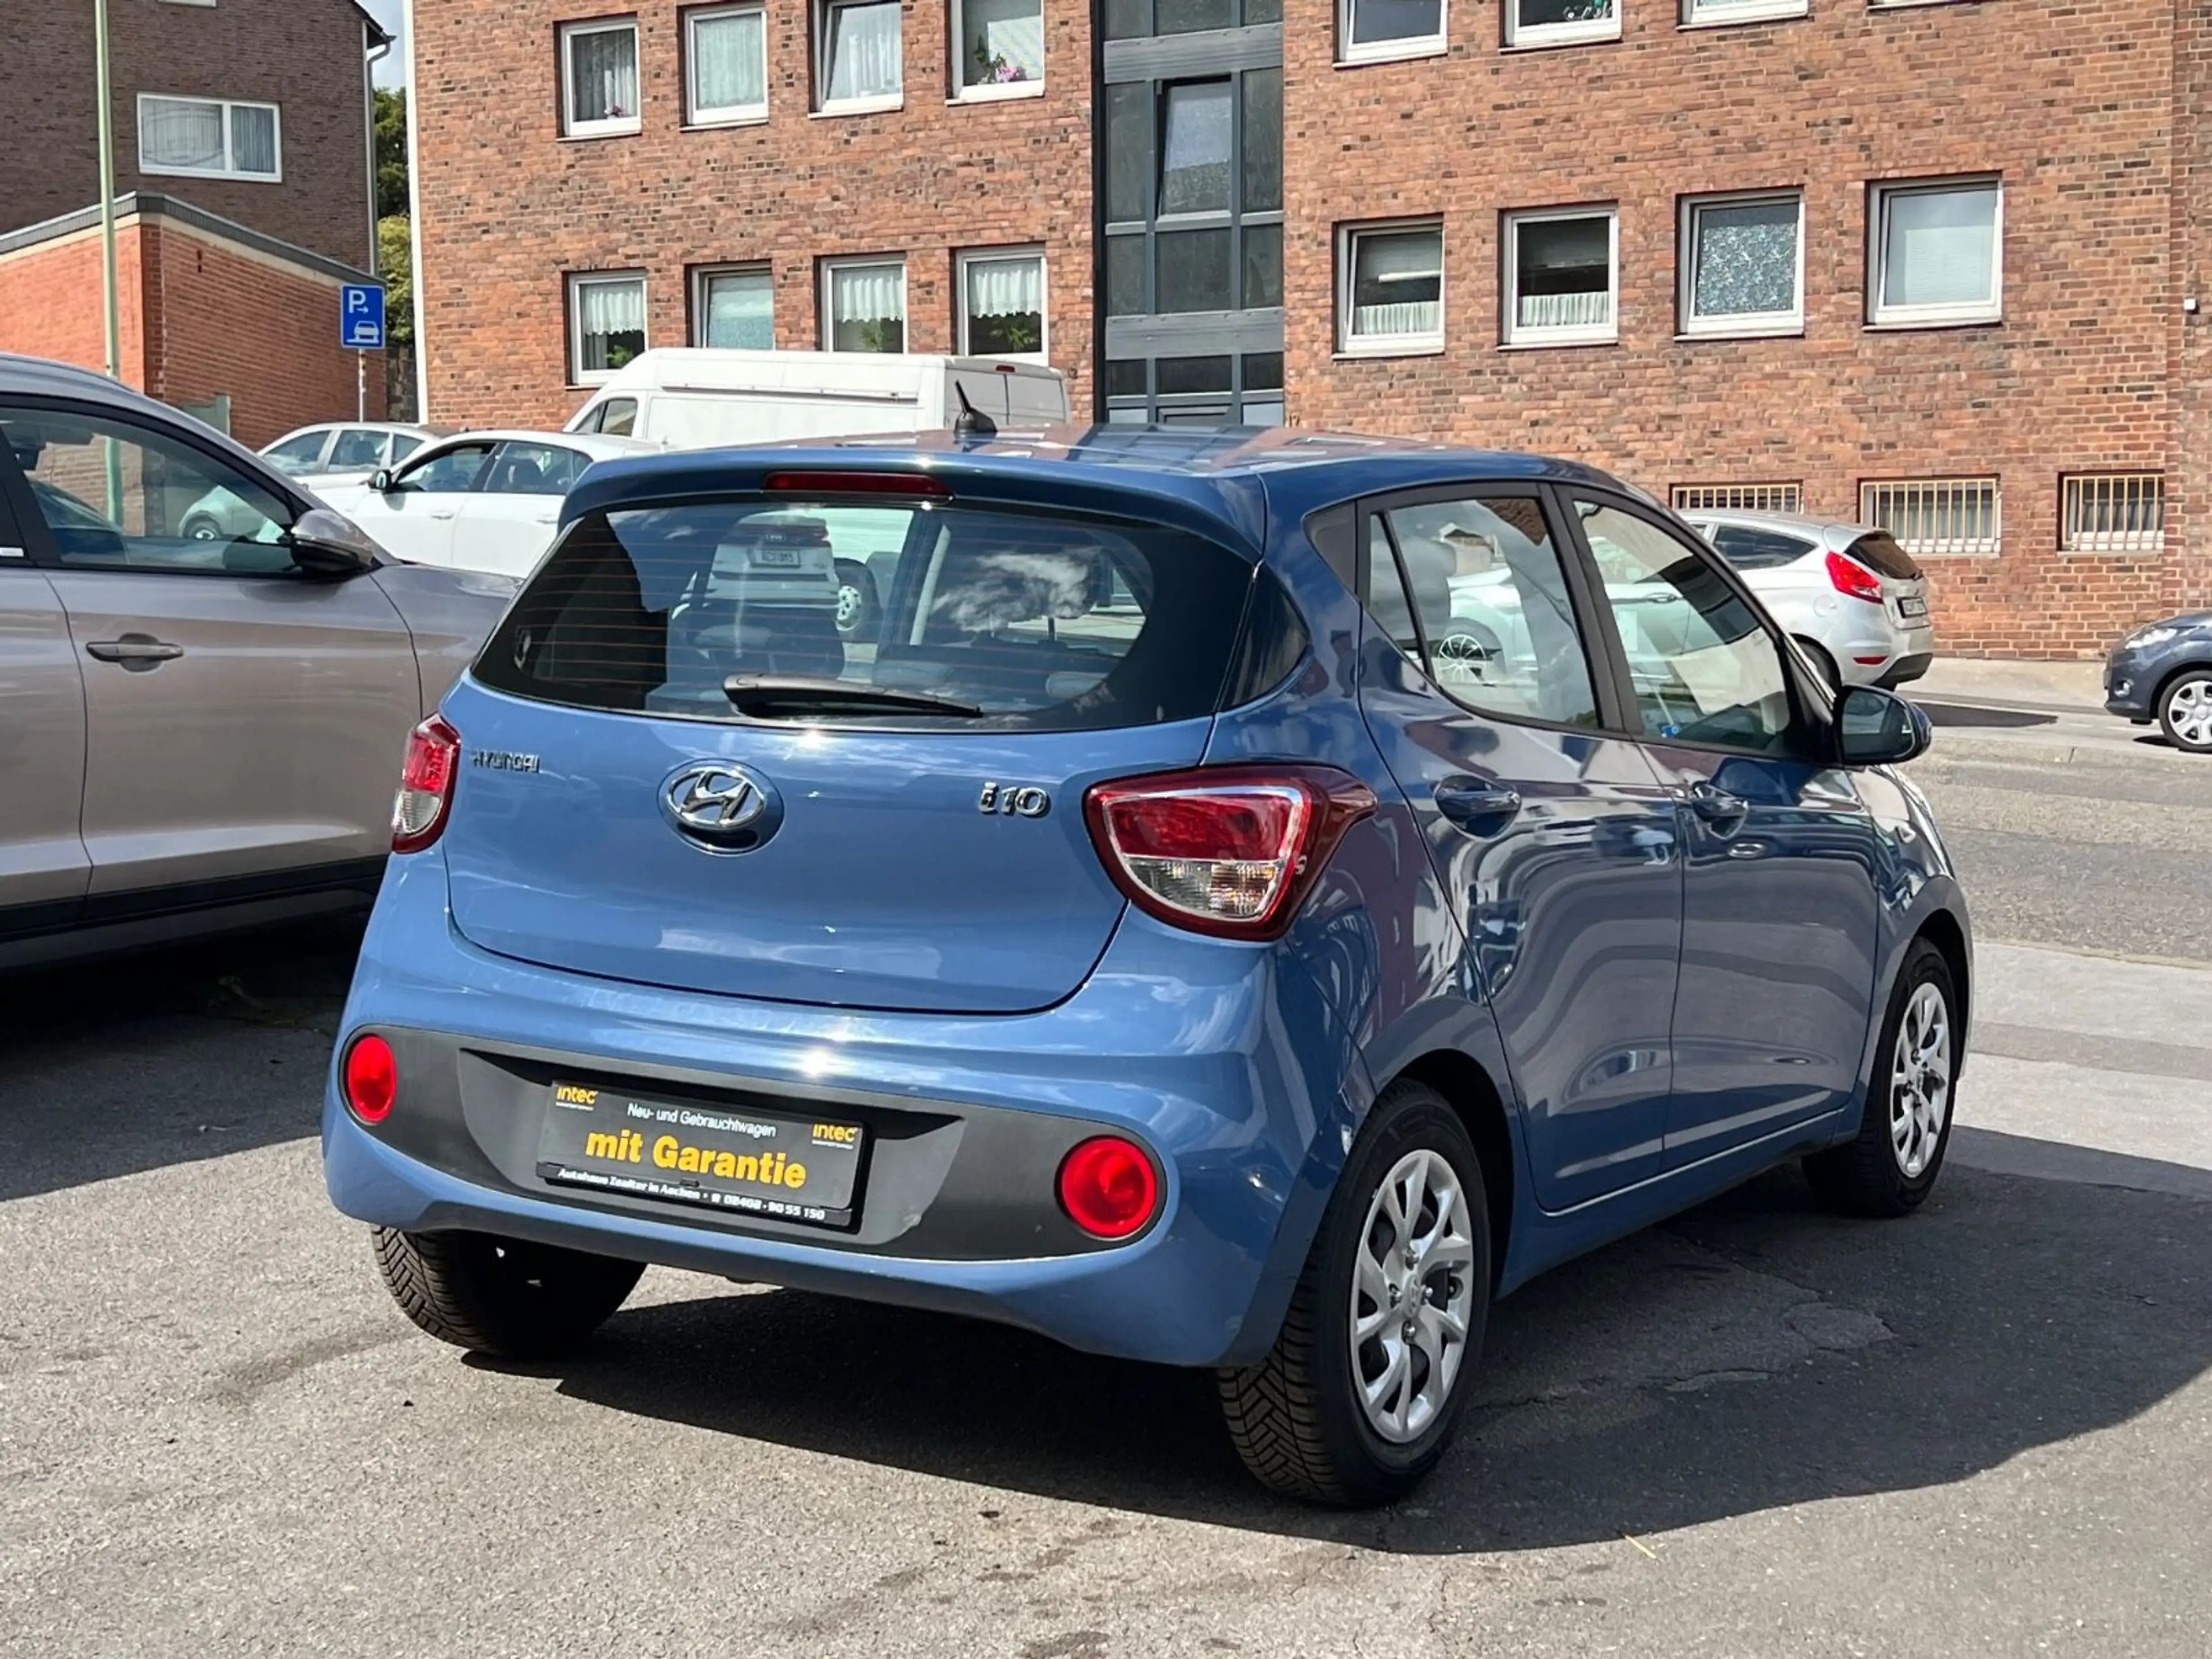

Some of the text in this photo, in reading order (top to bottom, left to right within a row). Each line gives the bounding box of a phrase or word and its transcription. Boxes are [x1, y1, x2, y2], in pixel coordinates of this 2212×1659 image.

[349, 290, 366, 313] P
[470, 750, 540, 773] HYUNDAI
[979, 782, 1051, 818] i10
[556, 1086, 599, 1105] intec
[627, 1103, 777, 1138] Neu- und Gebrauchtwagen
[813, 1124, 858, 1142] intec
[585, 1129, 807, 1188] mit Garantie
